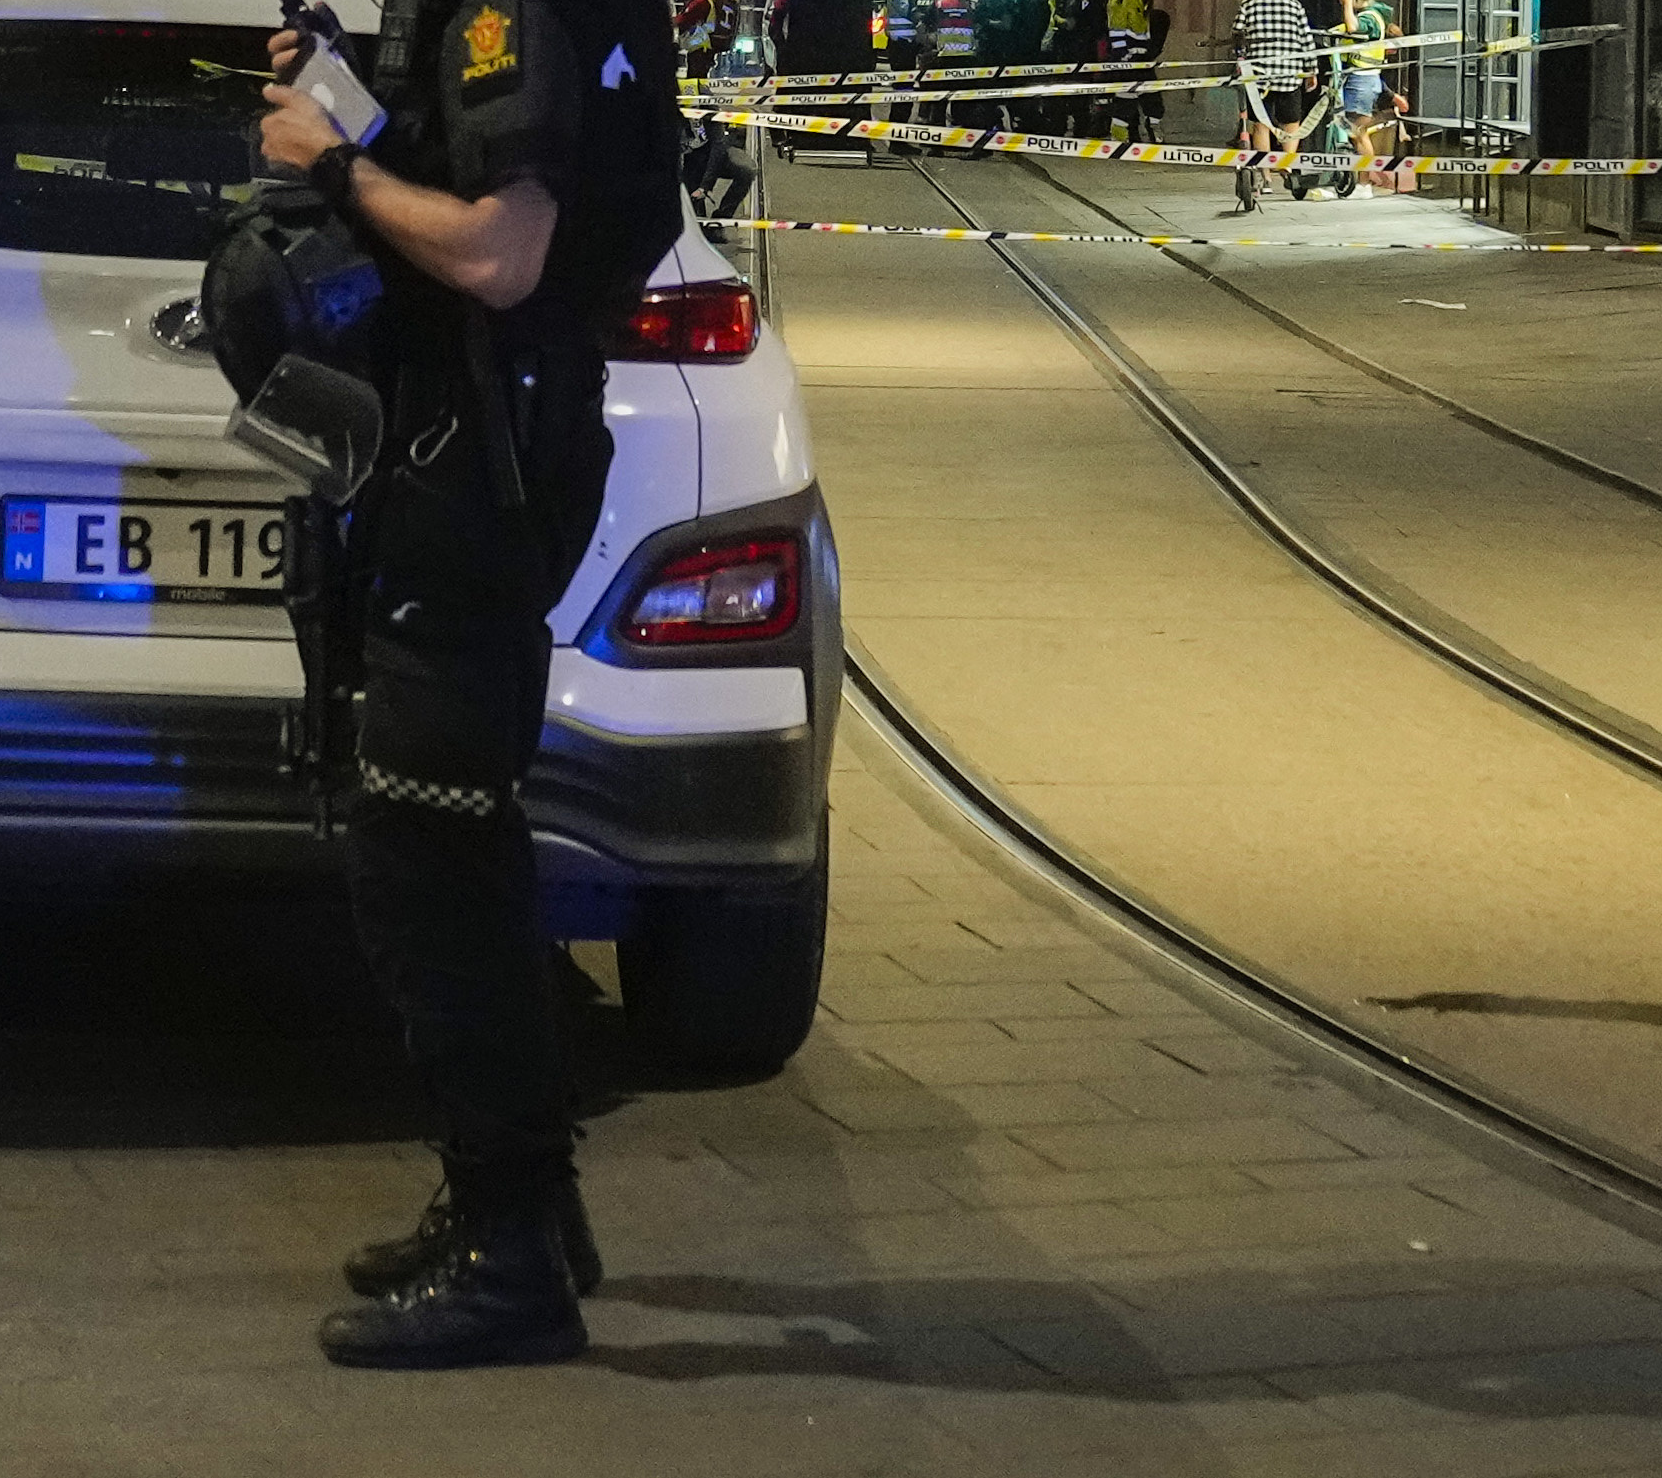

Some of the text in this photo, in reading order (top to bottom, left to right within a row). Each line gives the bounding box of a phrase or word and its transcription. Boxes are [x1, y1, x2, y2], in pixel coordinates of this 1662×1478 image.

[462, 54, 517, 81] POLITI
[890, 126, 943, 143] POLITI
[1027, 137, 1078, 153] POLITI
[1163, 149, 1214, 164] POLITI
[1299, 154, 1352, 168] POLITI
[1436, 159, 1488, 173] POLITI
[1572, 160, 1625, 172] POLITI
[75, 514, 153, 576] EB
[14, 551, 33, 571] N
